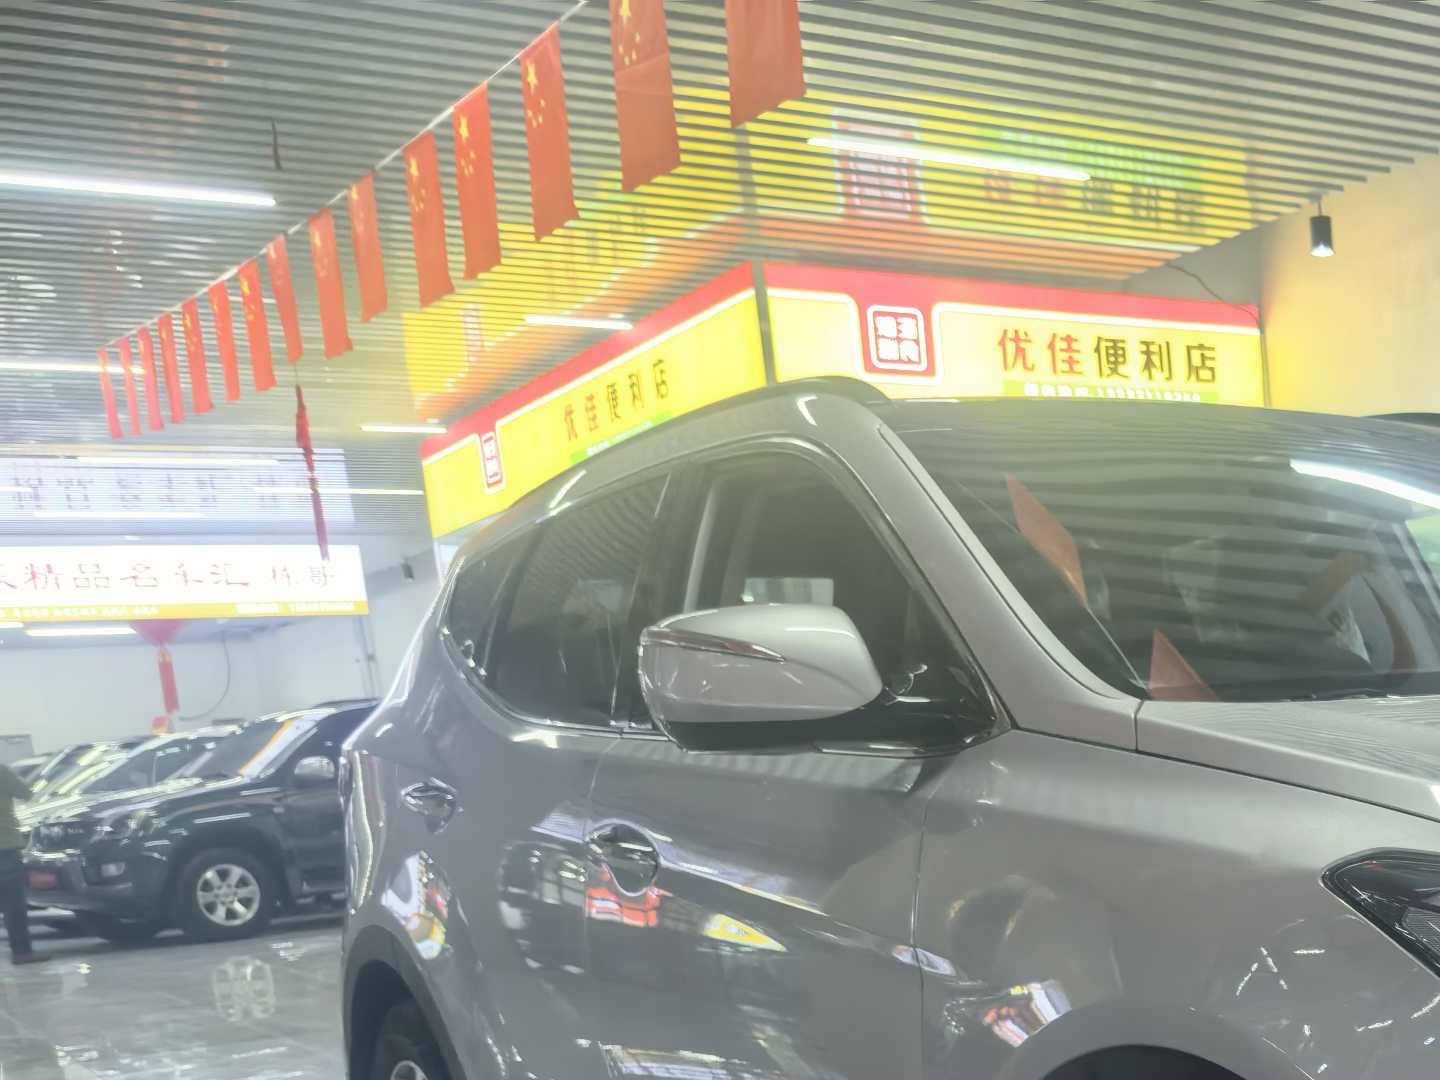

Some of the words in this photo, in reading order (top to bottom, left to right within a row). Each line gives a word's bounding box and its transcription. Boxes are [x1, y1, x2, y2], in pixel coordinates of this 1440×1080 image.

[998, 328, 1217, 383] 优佳便利店
[564, 358, 669, 441] 优佳便利店
